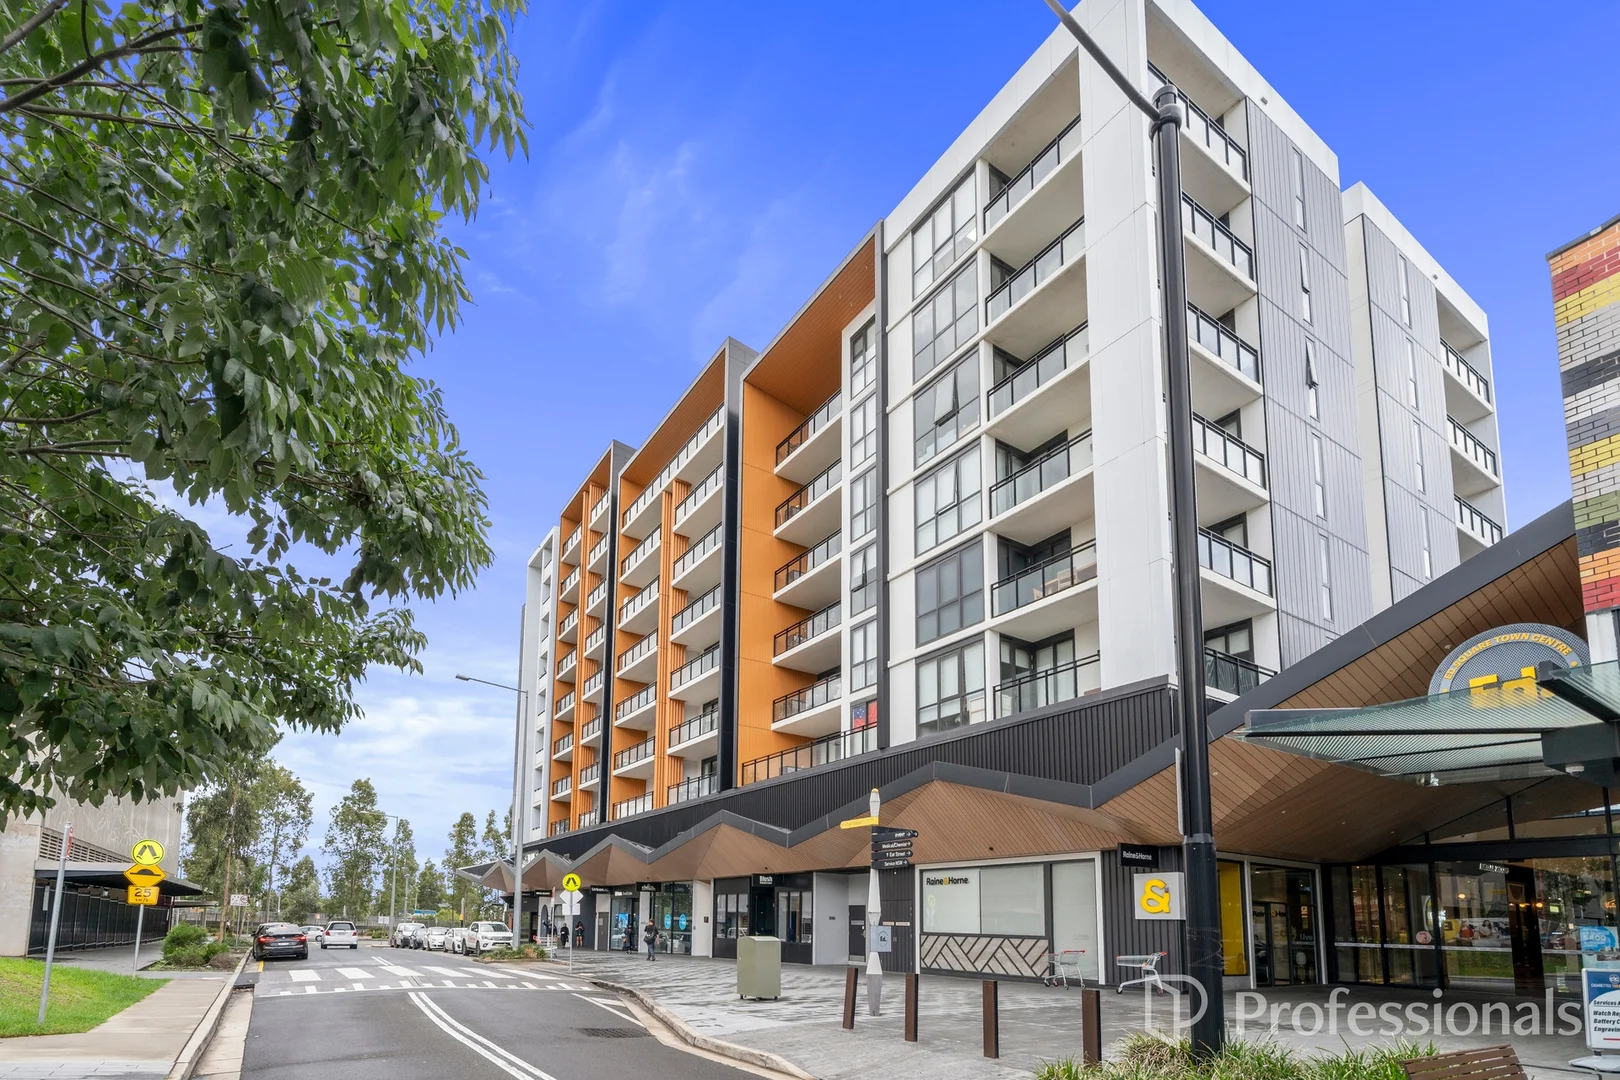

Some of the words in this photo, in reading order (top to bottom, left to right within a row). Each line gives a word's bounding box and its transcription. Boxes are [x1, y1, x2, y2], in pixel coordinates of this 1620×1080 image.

[1494, 632, 1530, 644] TOWN
[1531, 633, 1573, 656] CENTRE
[1122, 850, 1152, 861] Raine&Horne
[926, 876, 969, 886] Raine&Horne
[134, 887, 151, 897] 25
